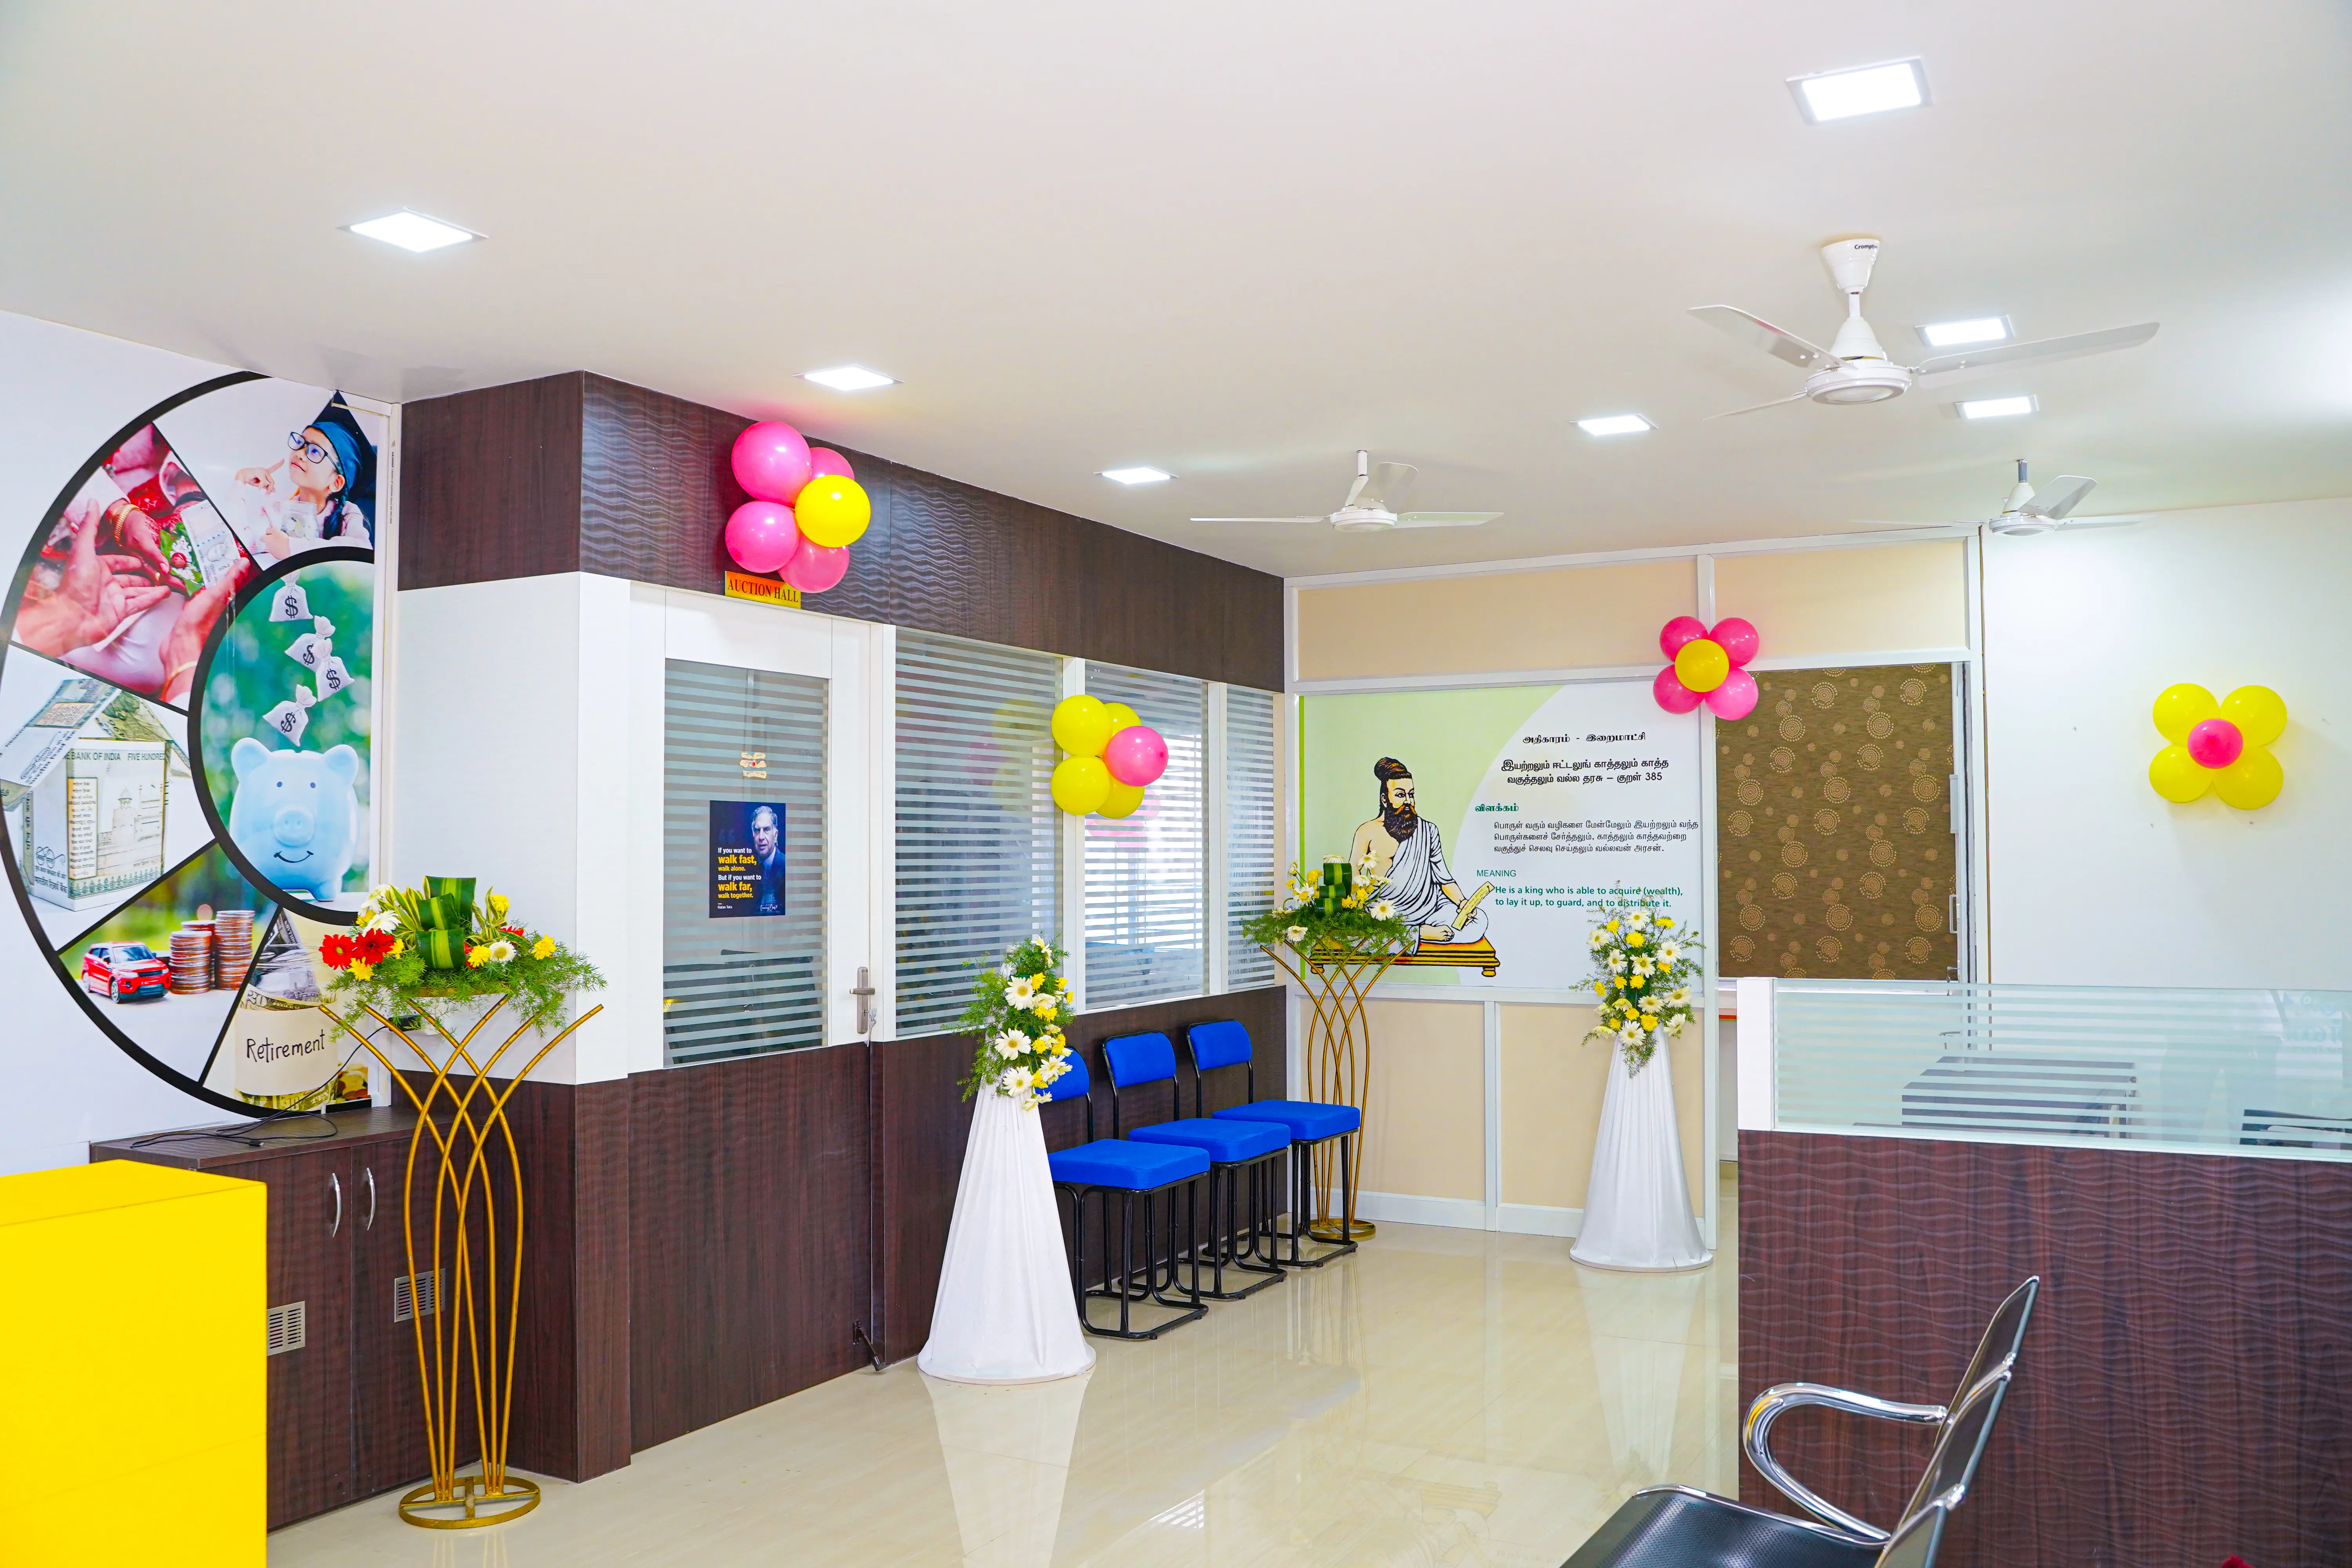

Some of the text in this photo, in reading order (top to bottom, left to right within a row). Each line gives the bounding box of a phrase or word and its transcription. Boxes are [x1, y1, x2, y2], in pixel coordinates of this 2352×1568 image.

[728, 579, 799, 603] AUCTION HALL
[1523, 733, 1570, 745] அதிகாரம்
[1586, 731, 1646, 744] இறைமாட்சி
[70, 751, 91, 760] BANK
[93, 752, 102, 760] OF
[104, 752, 121, 761] INDIA
[1501, 757, 1669, 773] இயற்றலும் ஈட்டலுங் காத்தலும் காத்த
[1507, 773, 1554, 786] வகுத்தலும்
[1557, 773, 1580, 782] வல்ல
[1583, 775, 1603, 785] தரசு
[1617, 771, 1642, 784] குறள்
[1645, 772, 1662, 781] 385
[1475, 802, 1519, 812] விளக்கம்
[1494, 819, 1699, 831] பொருள் வரும் வழிகளை மேன்மேலும் இயற்றலும் வந்த
[1494, 831, 1686, 842] பொருள்களைச் சேர்த்தலும், காத்தலும் காத்தவற்றை
[1494, 843, 1664, 854] வகுத்துச் செலவு செய்தலும் வல்லவன் அரசன்.
[718, 855, 757, 866] walk fast,
[718, 882, 752, 892] walk far,
[1524, 886, 1543, 896] king
[1545, 886, 1565, 894] who
[1576, 886, 1595, 894] able
[1609, 886, 1641, 897] acquire
[1643, 887, 1683, 897] (wealth),
[1506, 897, 1519, 907] lay
[1557, 898, 1584, 908] guard,
[1587, 898, 1603, 907] and
[1617, 898, 1660, 907] distribute
[1662, 899, 1671, 907] it.
[247, 1029, 325, 1063] Retirement
